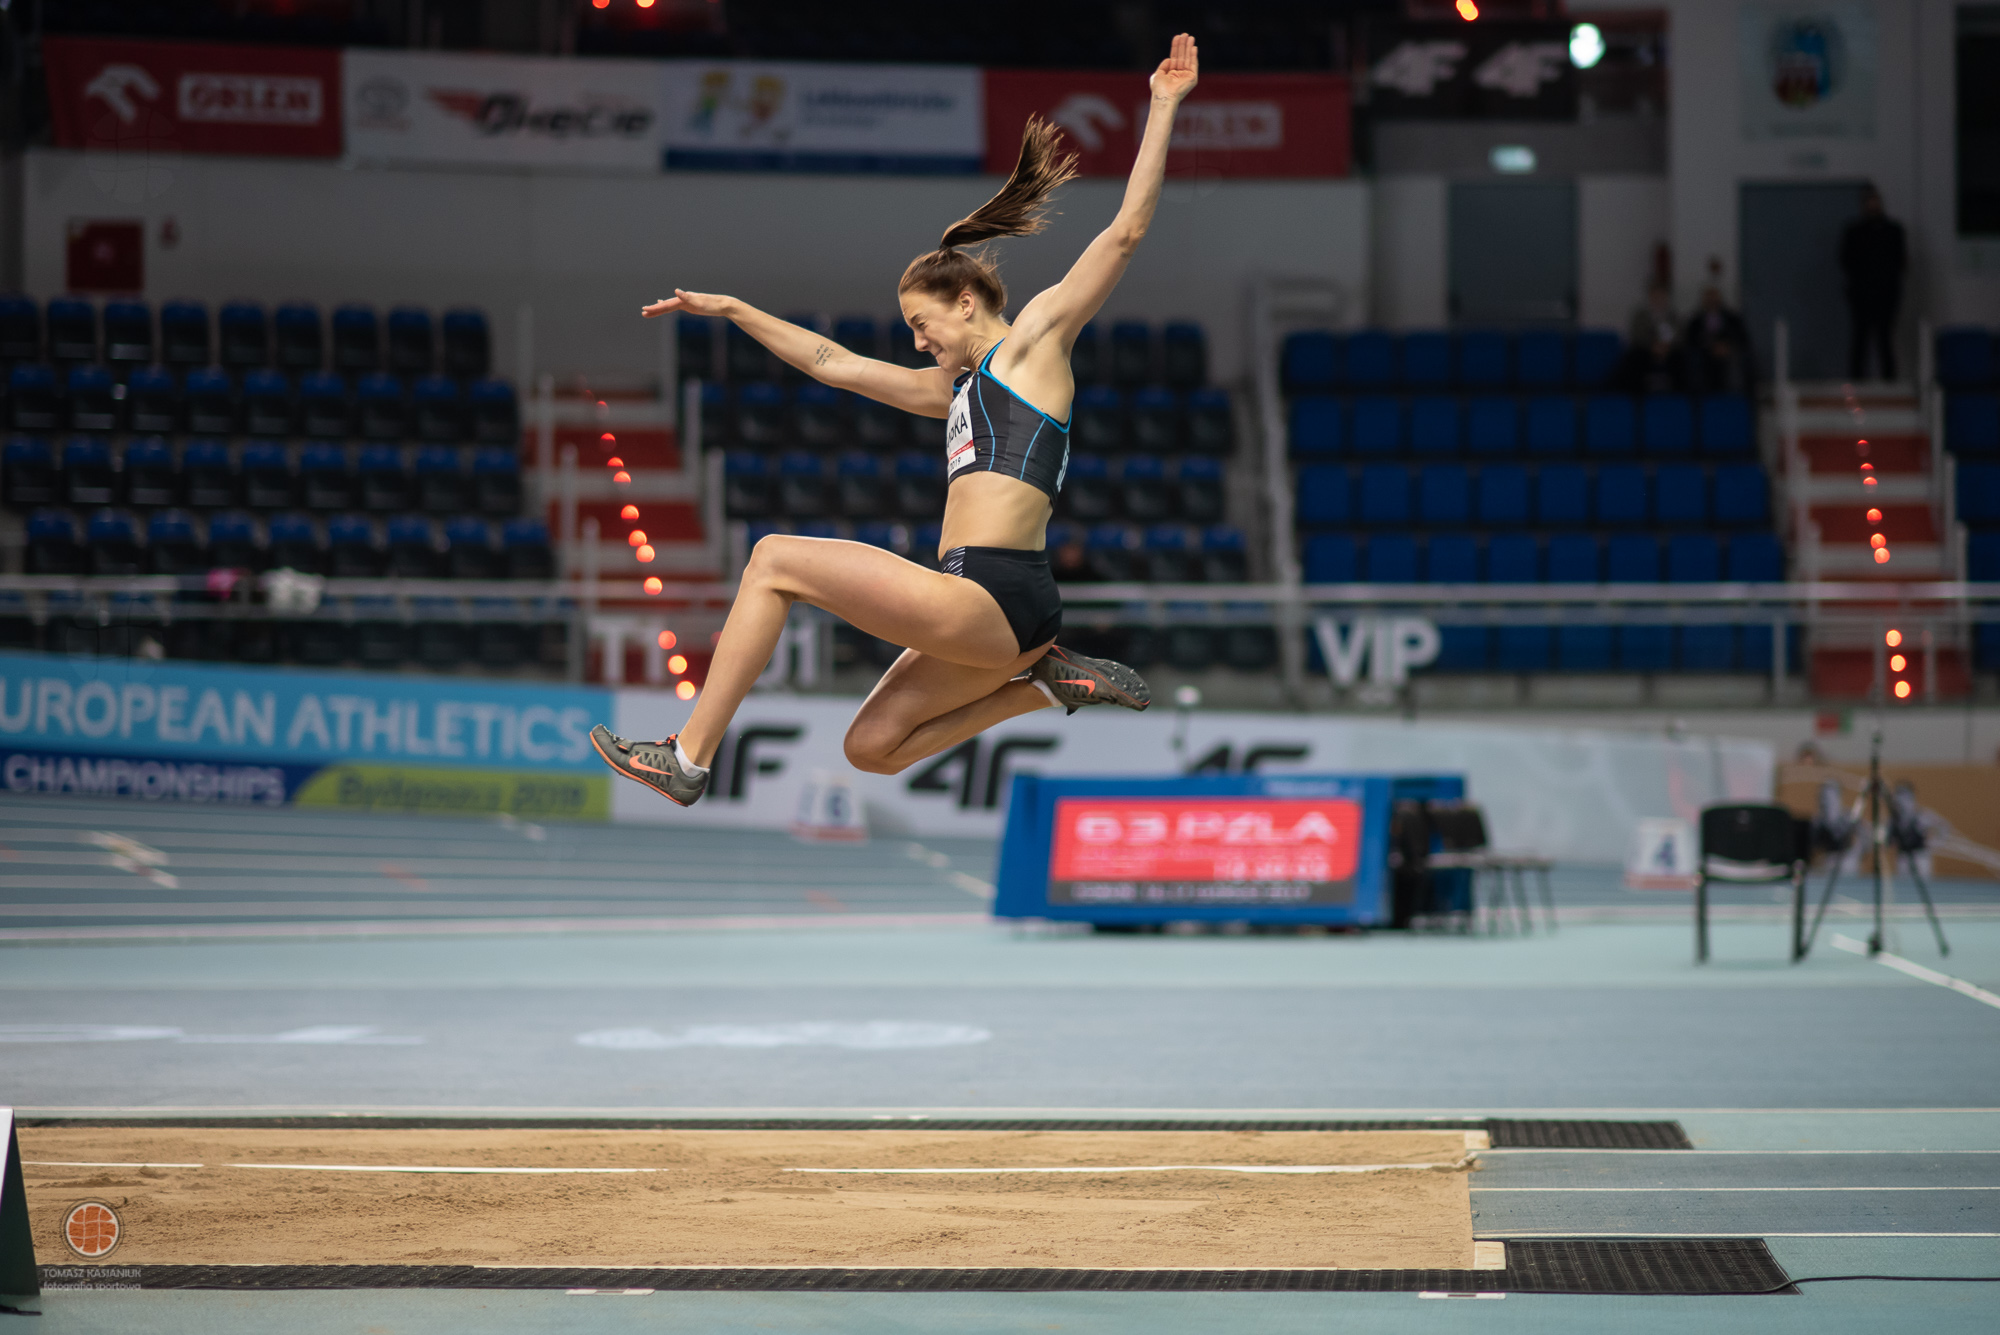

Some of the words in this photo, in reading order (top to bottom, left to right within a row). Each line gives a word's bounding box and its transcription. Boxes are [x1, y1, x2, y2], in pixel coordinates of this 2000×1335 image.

[1313, 614, 1441, 687] VIP
[287, 696, 591, 763] ATHLETICS
[4, 754, 286, 806] CHAMPIONSHIPS
